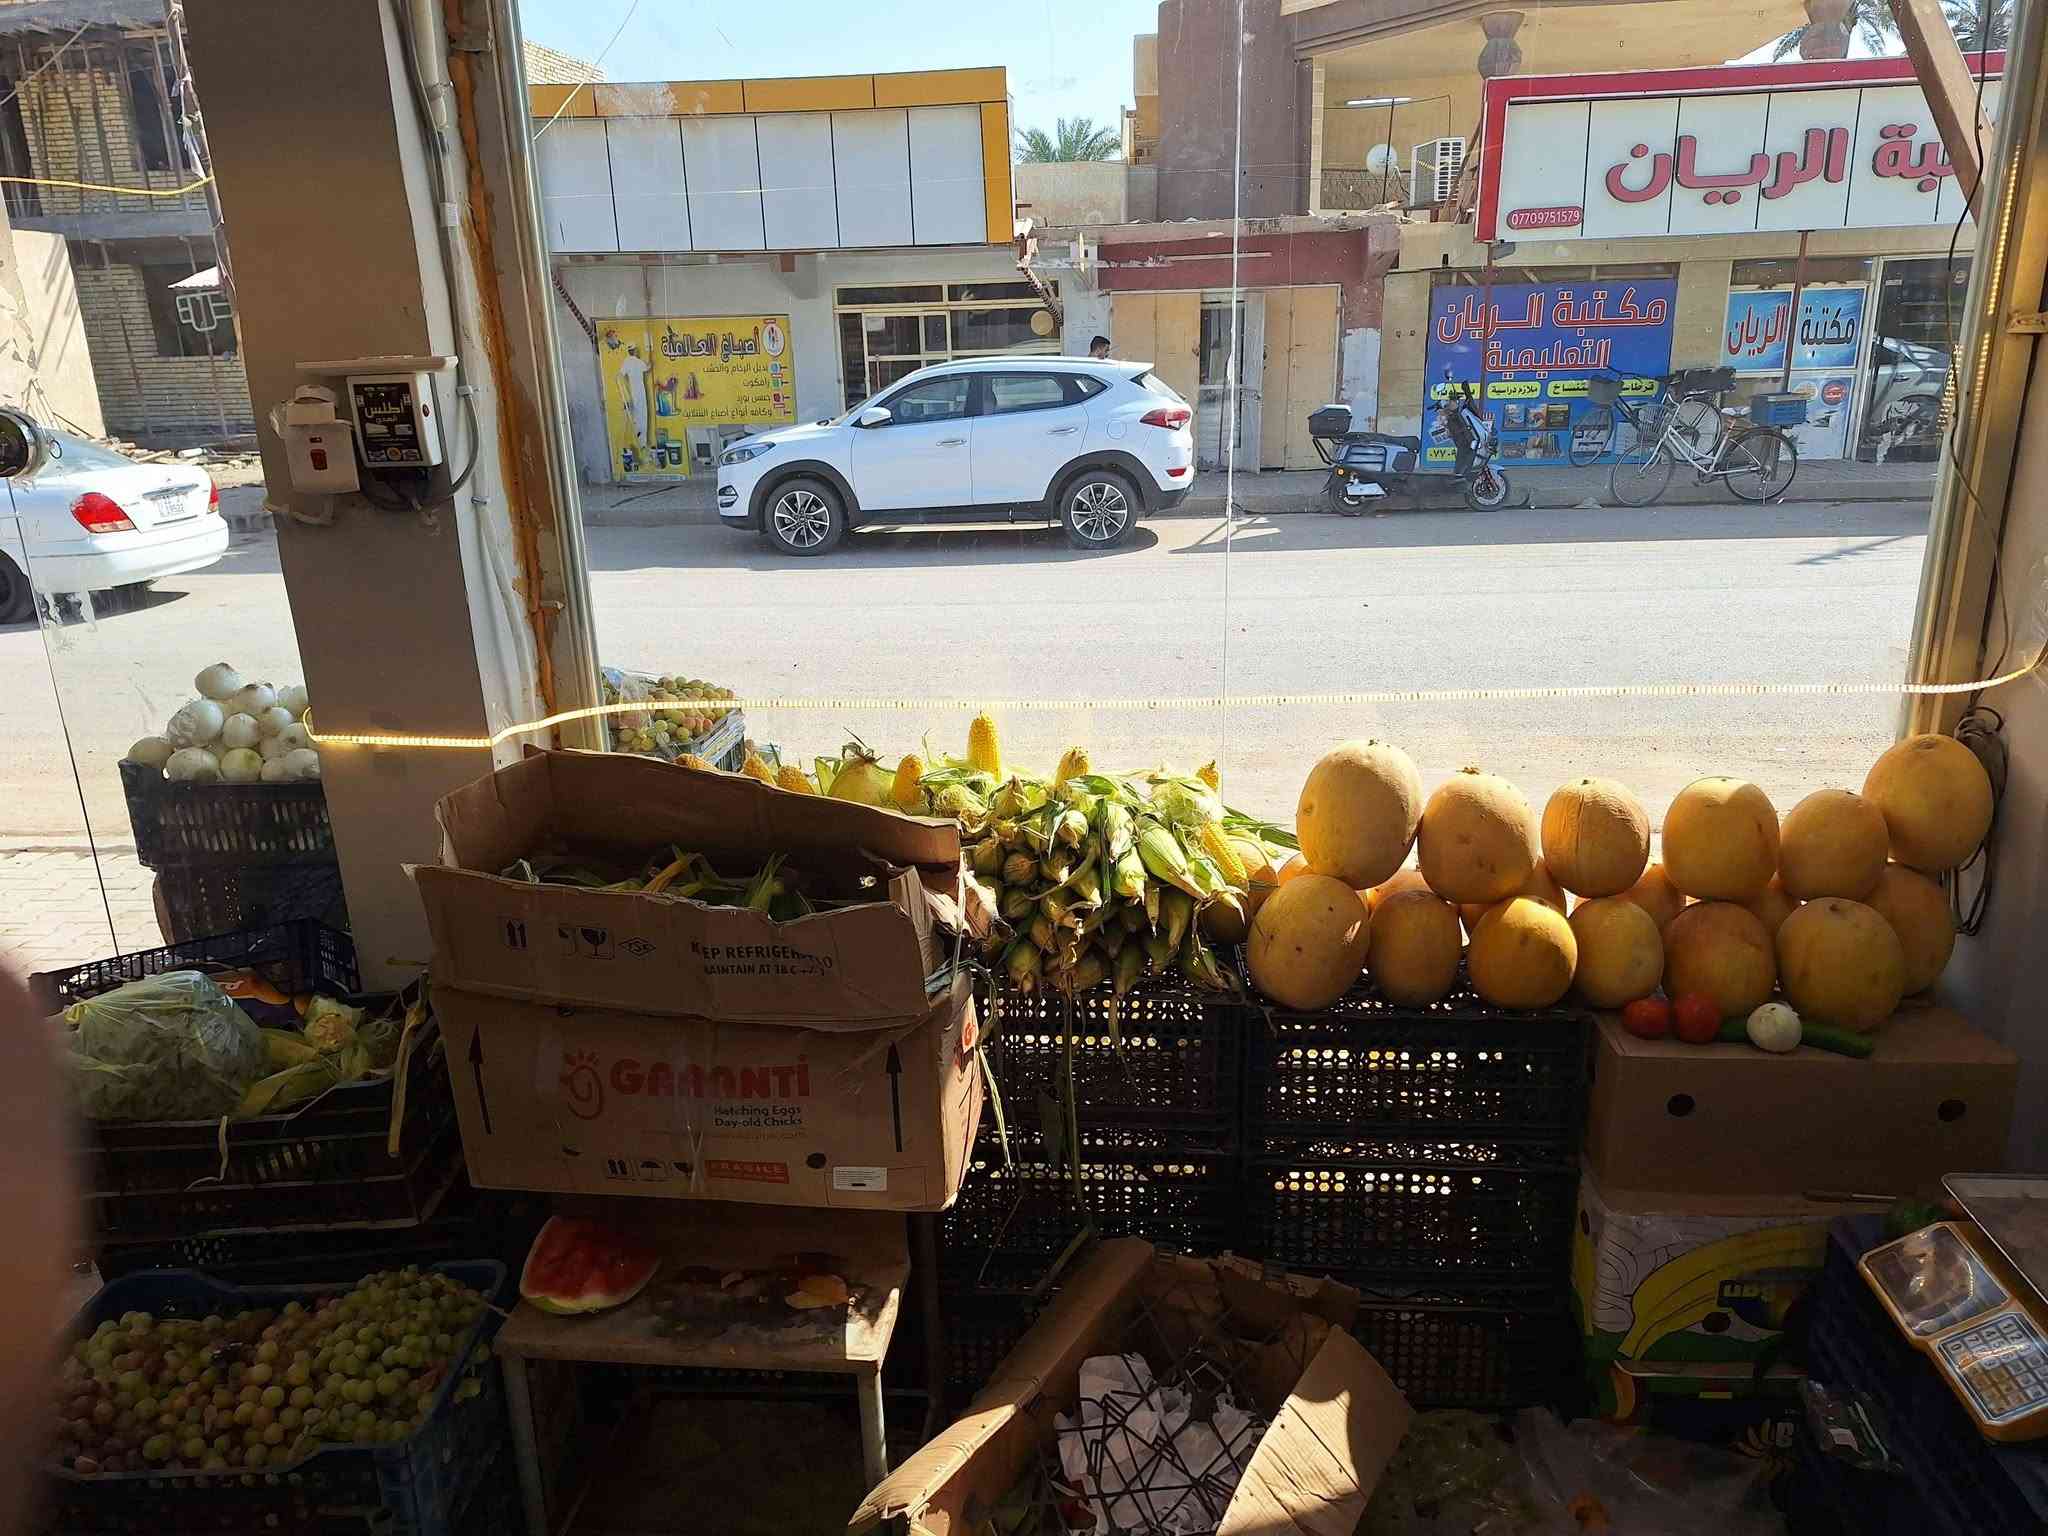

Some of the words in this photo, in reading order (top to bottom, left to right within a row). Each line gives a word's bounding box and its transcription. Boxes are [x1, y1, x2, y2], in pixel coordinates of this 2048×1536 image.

[1605, 127, 1849, 203] الريان
[1511, 210, 1580, 225] 07709751579
[1437, 292, 1544, 343] الريان
[1552, 288, 1668, 336] مكتبة
[1728, 304, 1788, 355] الريان
[1801, 306, 1855, 357] مكتبة
[1486, 338, 1612, 379] التعليمية
[1491, 384, 1517, 395] دراسية
[1518, 384, 1537, 395] ملازم
[714, 1105, 769, 1117] Hatching
[714, 1117, 761, 1128] Day-old
[763, 1117, 802, 1128] Chicks
